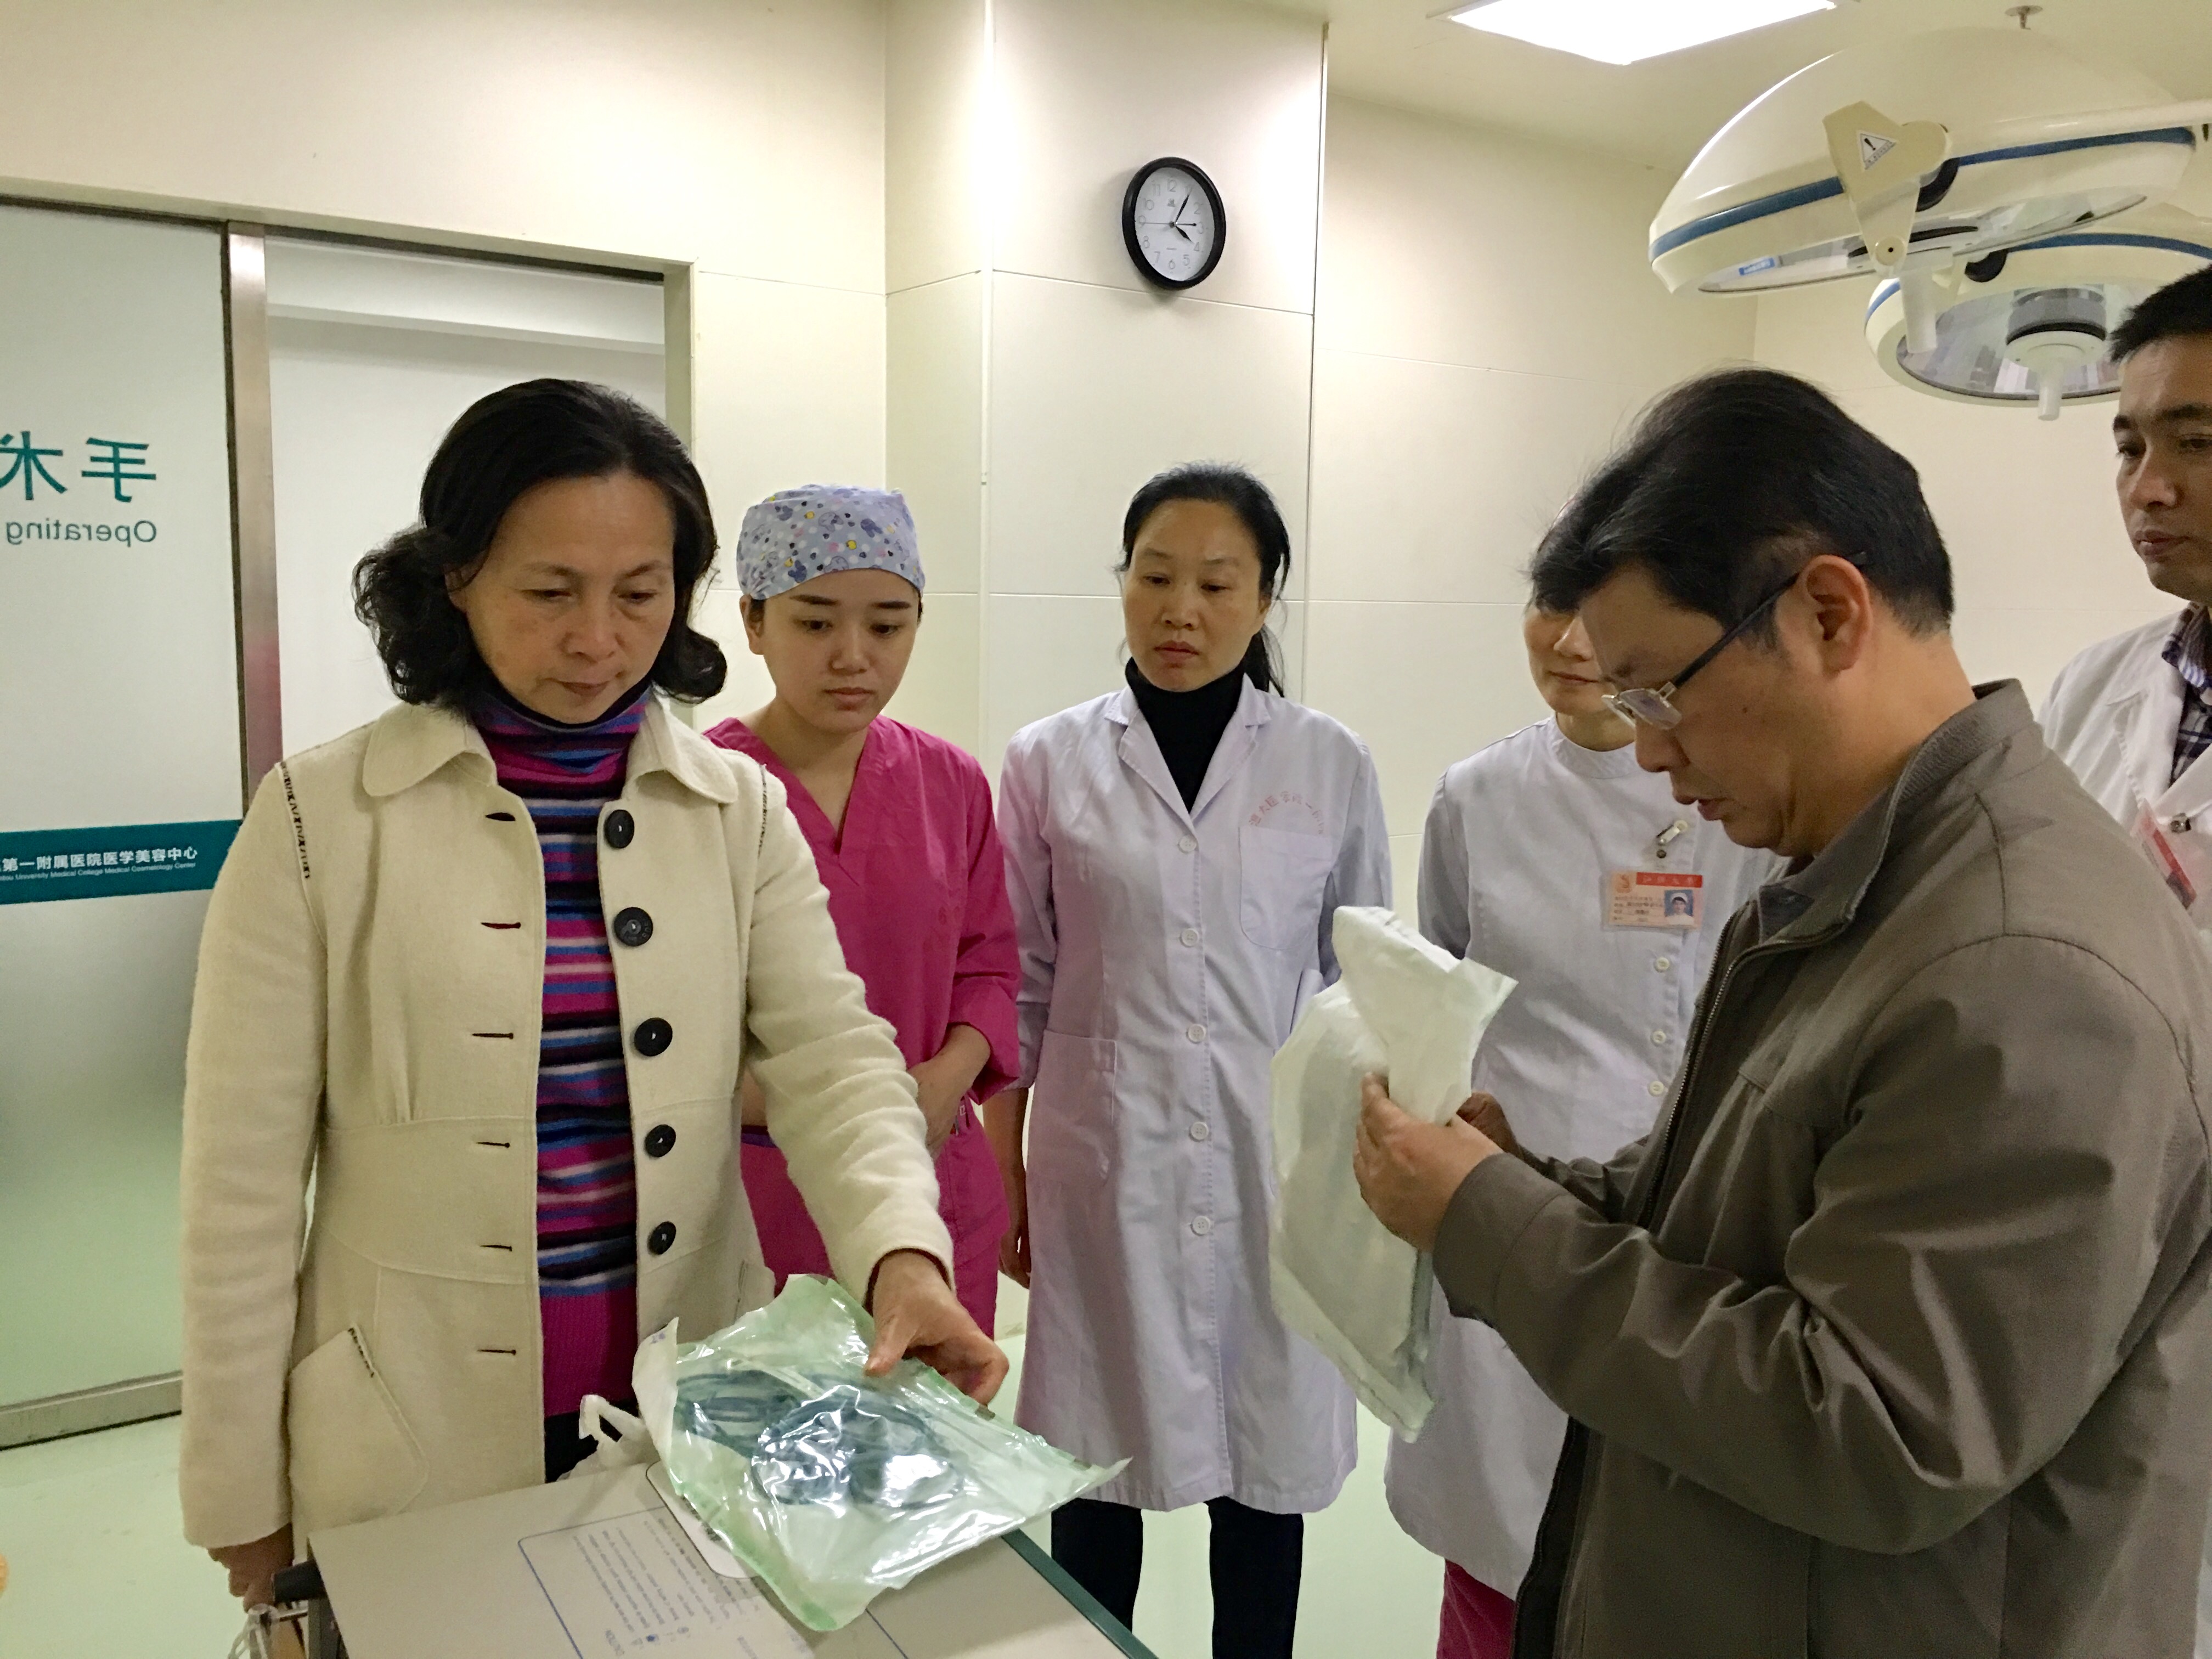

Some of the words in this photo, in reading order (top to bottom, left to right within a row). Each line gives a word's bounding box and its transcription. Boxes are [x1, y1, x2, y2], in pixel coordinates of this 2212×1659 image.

[1166, 179, 1177, 192] 12
[1193, 201, 1201, 215] 2
[1138, 215, 1146, 229] 9
[1143, 235, 1150, 249] 8
[1193, 241, 1200, 251] 4
[1153, 251, 1160, 264] 7
[1167, 258, 1176, 270] 6
[1182, 254, 1190, 266] 5
[0, 846, 198, 873] 第一附属医院医学美容中心
